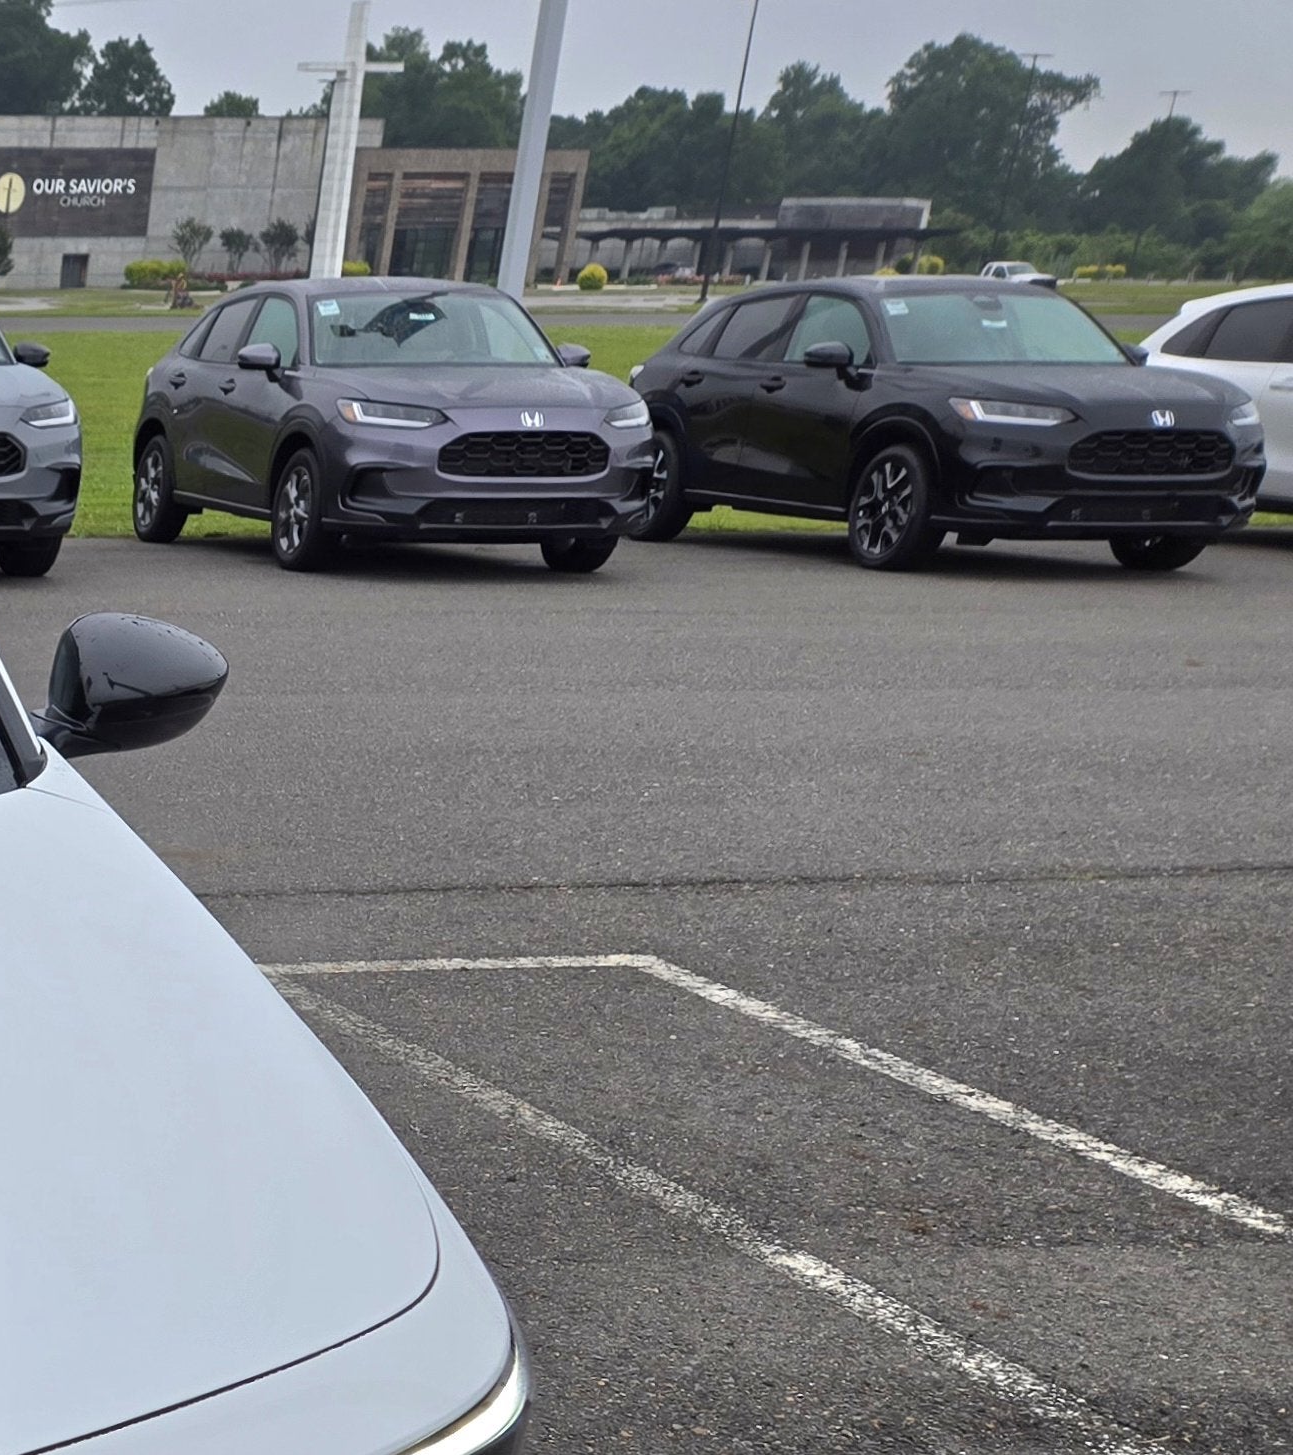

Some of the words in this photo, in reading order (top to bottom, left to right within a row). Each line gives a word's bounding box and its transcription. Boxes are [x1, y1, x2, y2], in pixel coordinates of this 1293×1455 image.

[32, 178, 66, 194] OUR
[68, 178, 137, 195] SAVIOR'S
[59, 195, 106, 208] CHURCH
